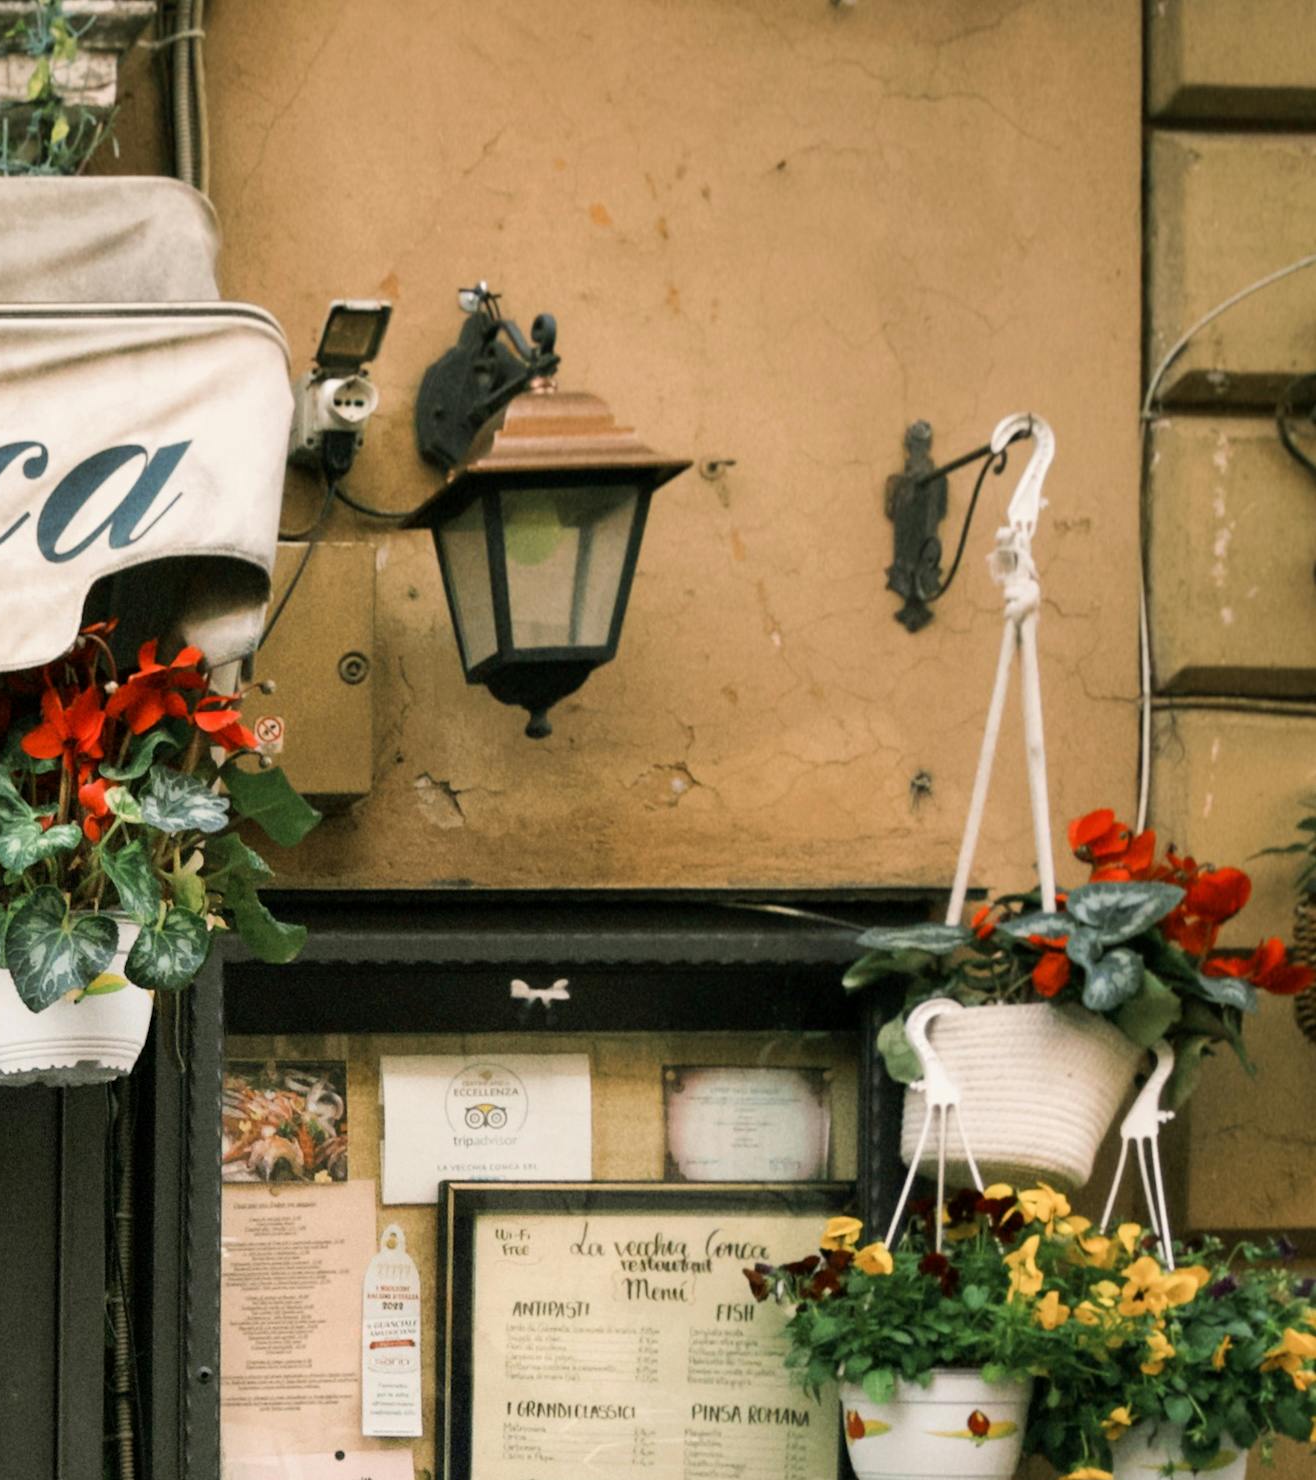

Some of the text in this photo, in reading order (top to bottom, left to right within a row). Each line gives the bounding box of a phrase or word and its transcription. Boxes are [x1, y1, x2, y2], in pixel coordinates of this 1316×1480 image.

[453, 1087, 520, 1098] ECCELLENZA
[453, 1135, 518, 1149] tripadvisor
[569, 1221, 605, 1257] La
[705, 1228, 770, 1260] Conca
[512, 1301, 590, 1319] ANTIPASTI
[716, 1303, 755, 1322] FISH
[507, 1400, 636, 1420] I GRANDI CLASSICI
[691, 1403, 810, 1427] PINSA ROMANA
